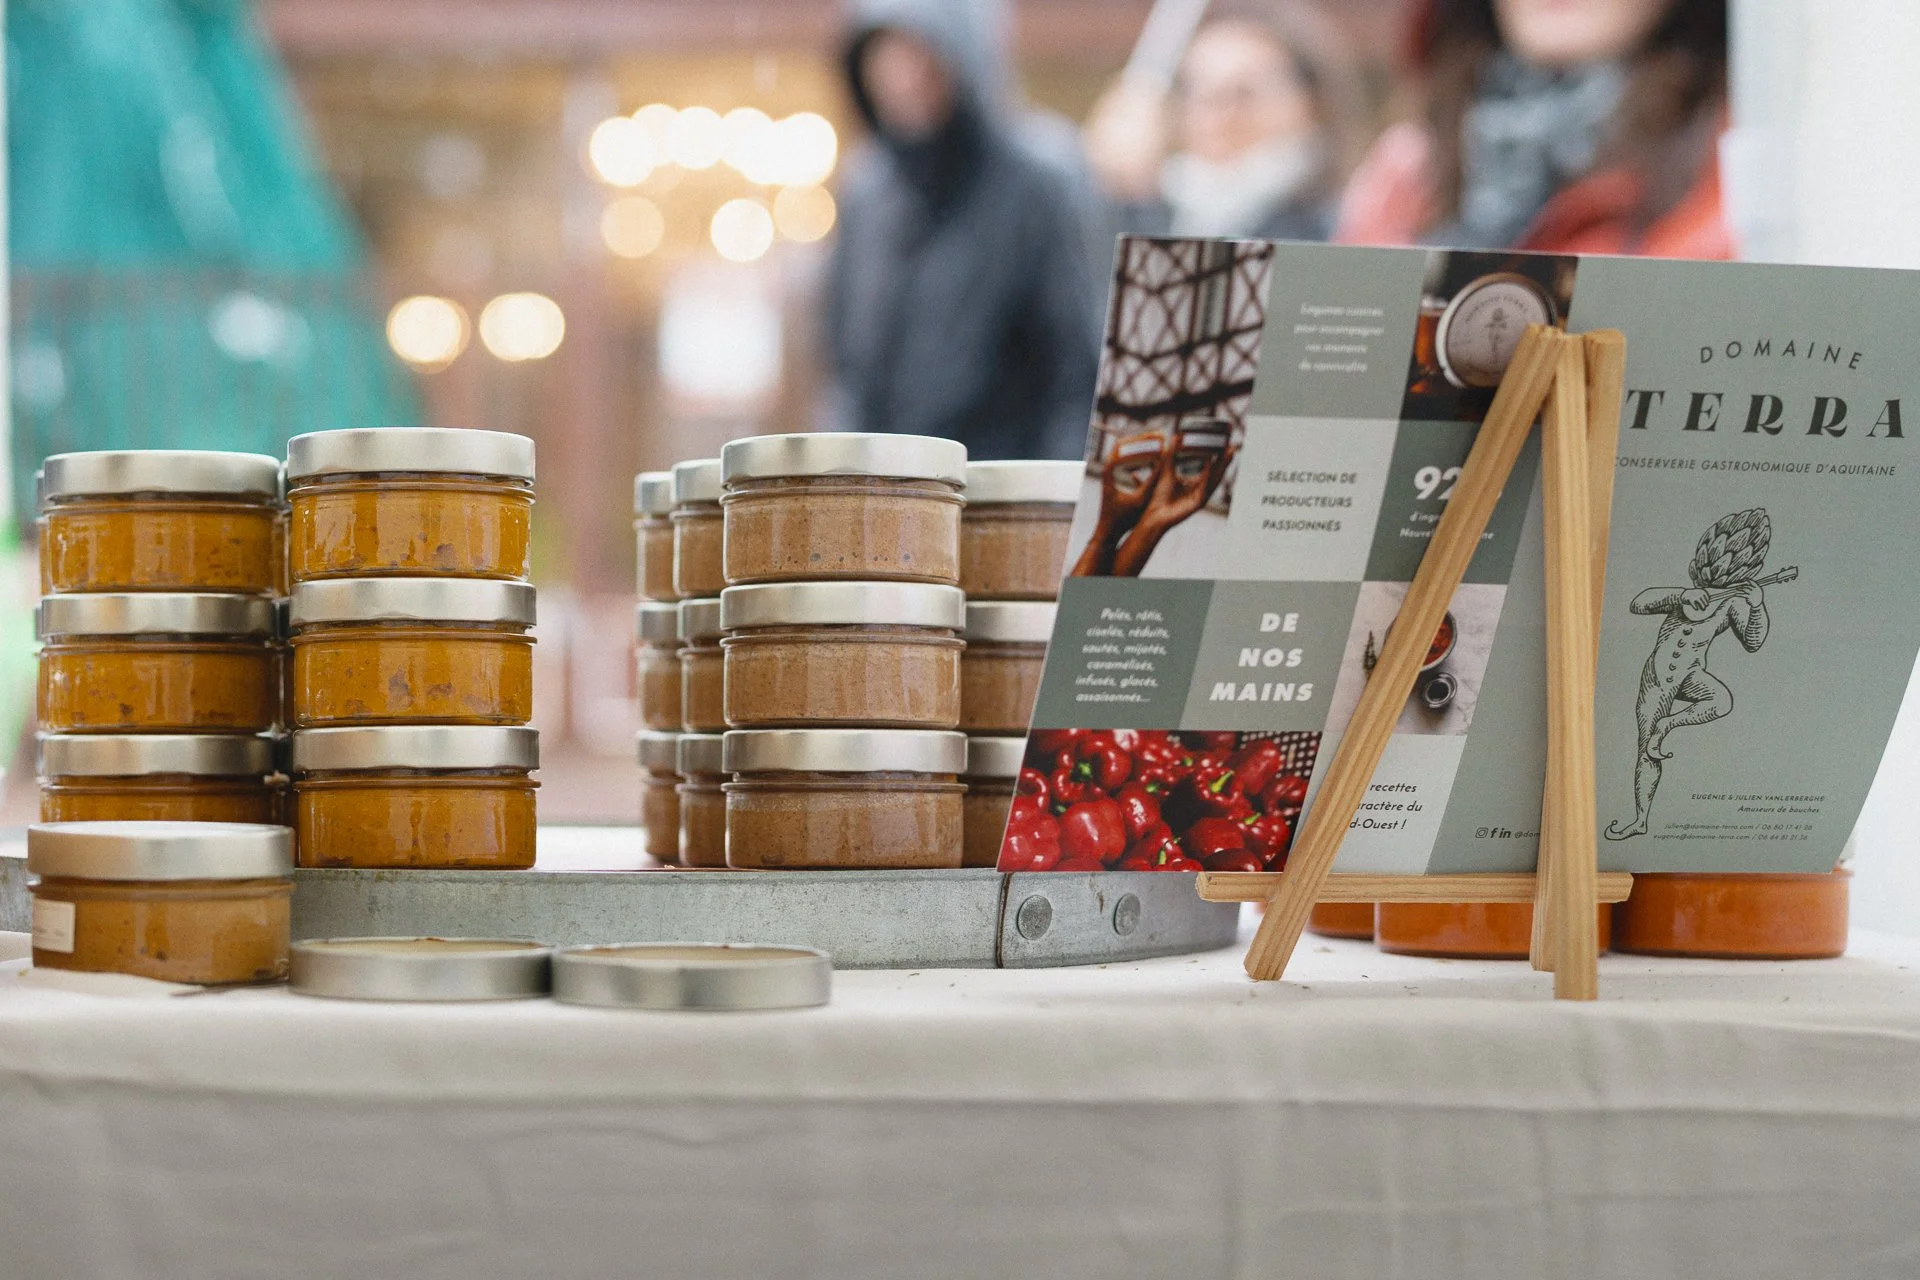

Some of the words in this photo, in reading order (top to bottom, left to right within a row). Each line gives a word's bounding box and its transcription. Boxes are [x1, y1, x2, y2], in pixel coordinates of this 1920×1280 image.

[1700, 338, 1862, 370] DOMAINE
[1626, 389, 1905, 439] TERRA
[1701, 460, 1811, 474] GASTRONOMIQUE
[1815, 463, 1897, 477] D'AQUITAINE
[1340, 471, 1358, 484] DE
[1261, 495, 1353, 508] PRODUCTEURS
[1260, 613, 1300, 633] DE
[1238, 647, 1304, 668] NOS
[1208, 682, 1315, 702] MAINS
[1370, 783, 1417, 793] recettes
[1357, 801, 1403, 811] ractère
[1406, 801, 1423, 812] du
[1737, 805, 1775, 813] Amuseurs
[1788, 806, 1820, 814] bouches
[1349, 817, 1399, 830] d-Ouest
[1400, 819, 1407, 830] !
